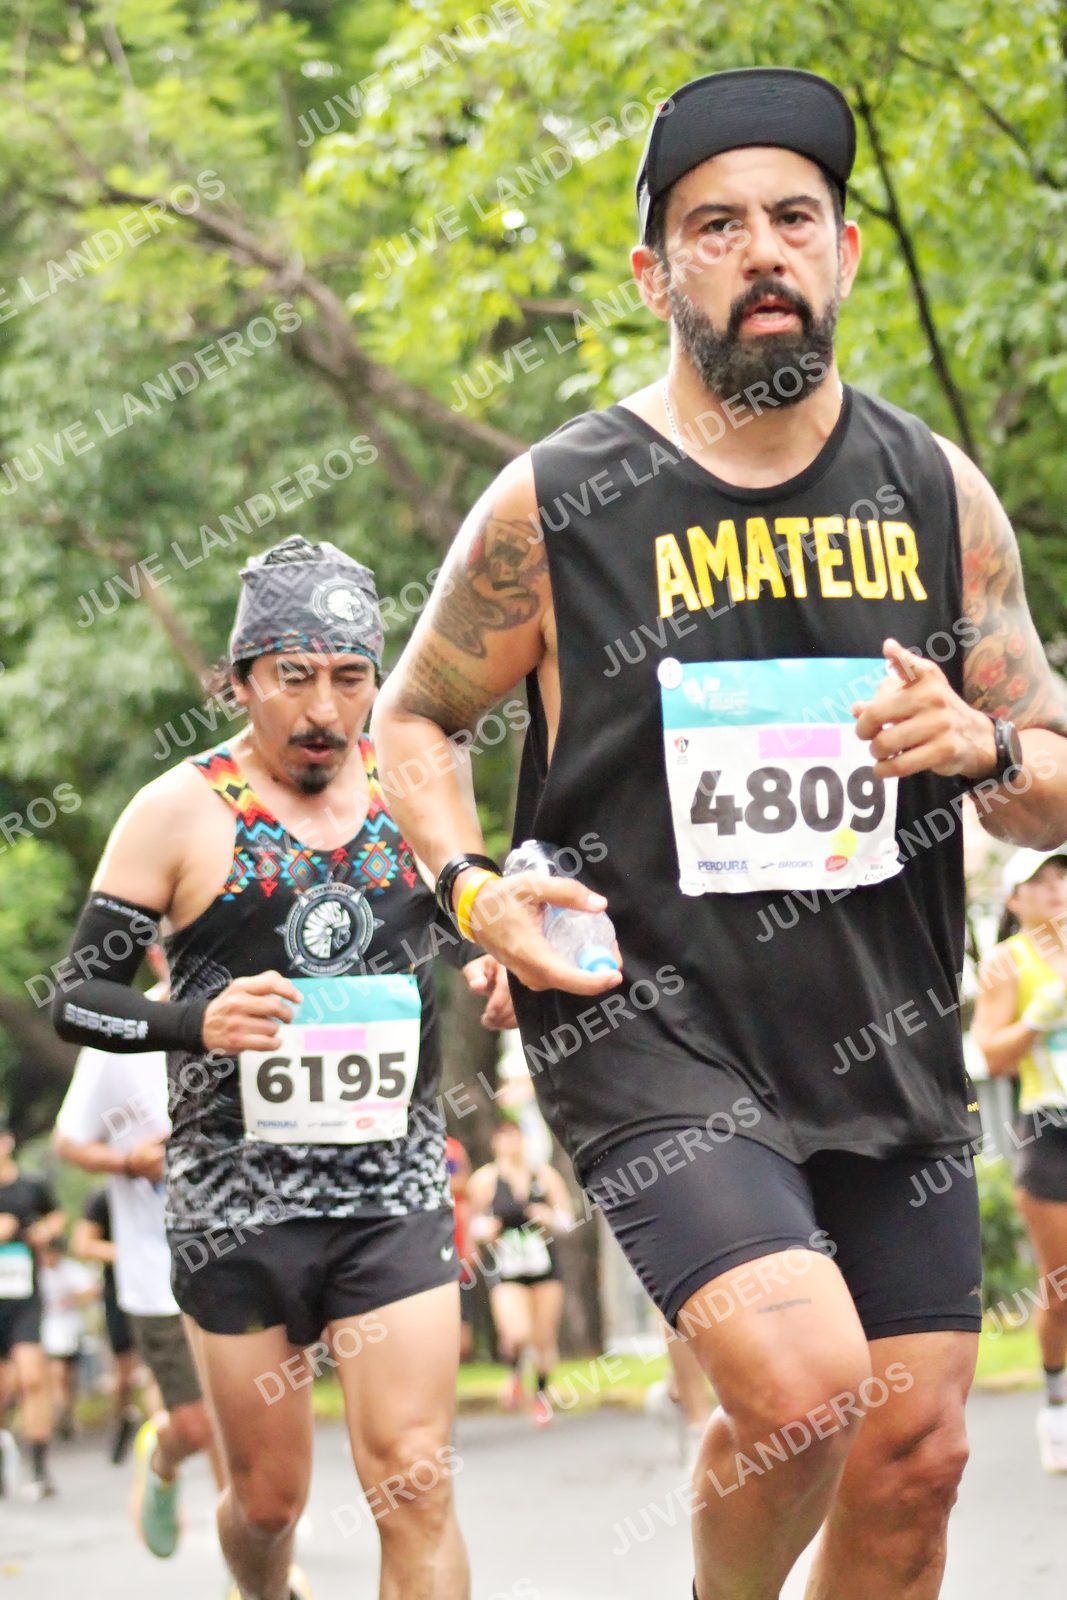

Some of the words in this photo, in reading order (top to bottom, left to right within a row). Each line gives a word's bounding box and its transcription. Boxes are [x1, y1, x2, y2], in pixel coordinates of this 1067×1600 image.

[655, 517, 927, 618] AMATEUR
[690, 766, 886, 836] 4809
[697, 860, 748, 871] PERDURA
[257, 1052, 406, 1103] 6195
